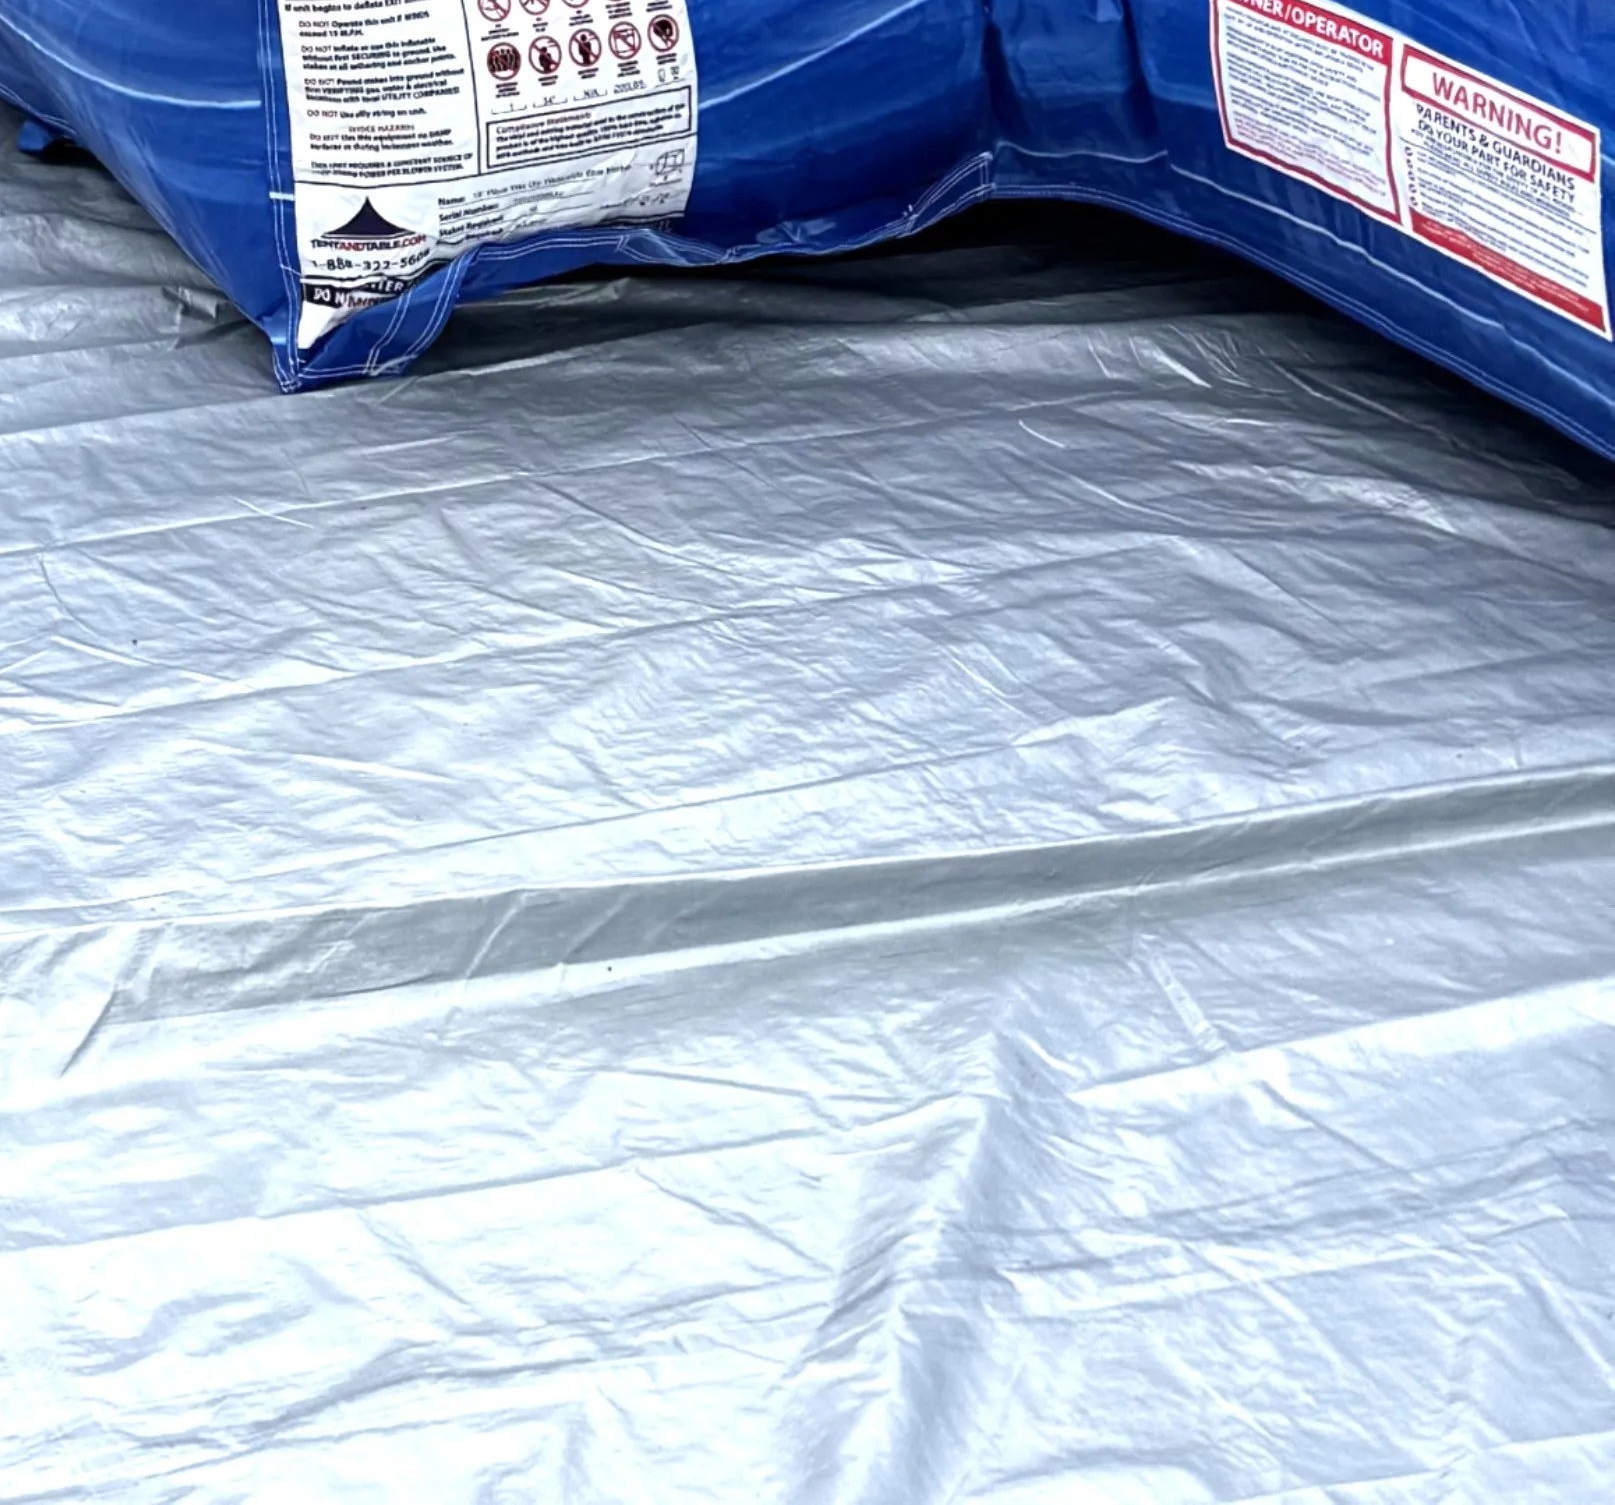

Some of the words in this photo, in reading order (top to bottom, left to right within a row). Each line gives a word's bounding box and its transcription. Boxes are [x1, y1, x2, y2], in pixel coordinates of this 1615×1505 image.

[293, 4, 311, 12] unit
[312, 3, 341, 13] begins
[354, 0, 383, 10] deflate
[1416, 103, 1475, 141] PARENTS
[1479, 133, 1489, 147] &
[1492, 141, 1575, 191] GUARDIANS
[1433, 71, 1562, 154] WARNING!
[1437, 129, 1469, 153] YOUR
[1471, 146, 1500, 166] PART
[1504, 162, 1527, 179] FOR
[1530, 175, 1574, 203] SAFETY
